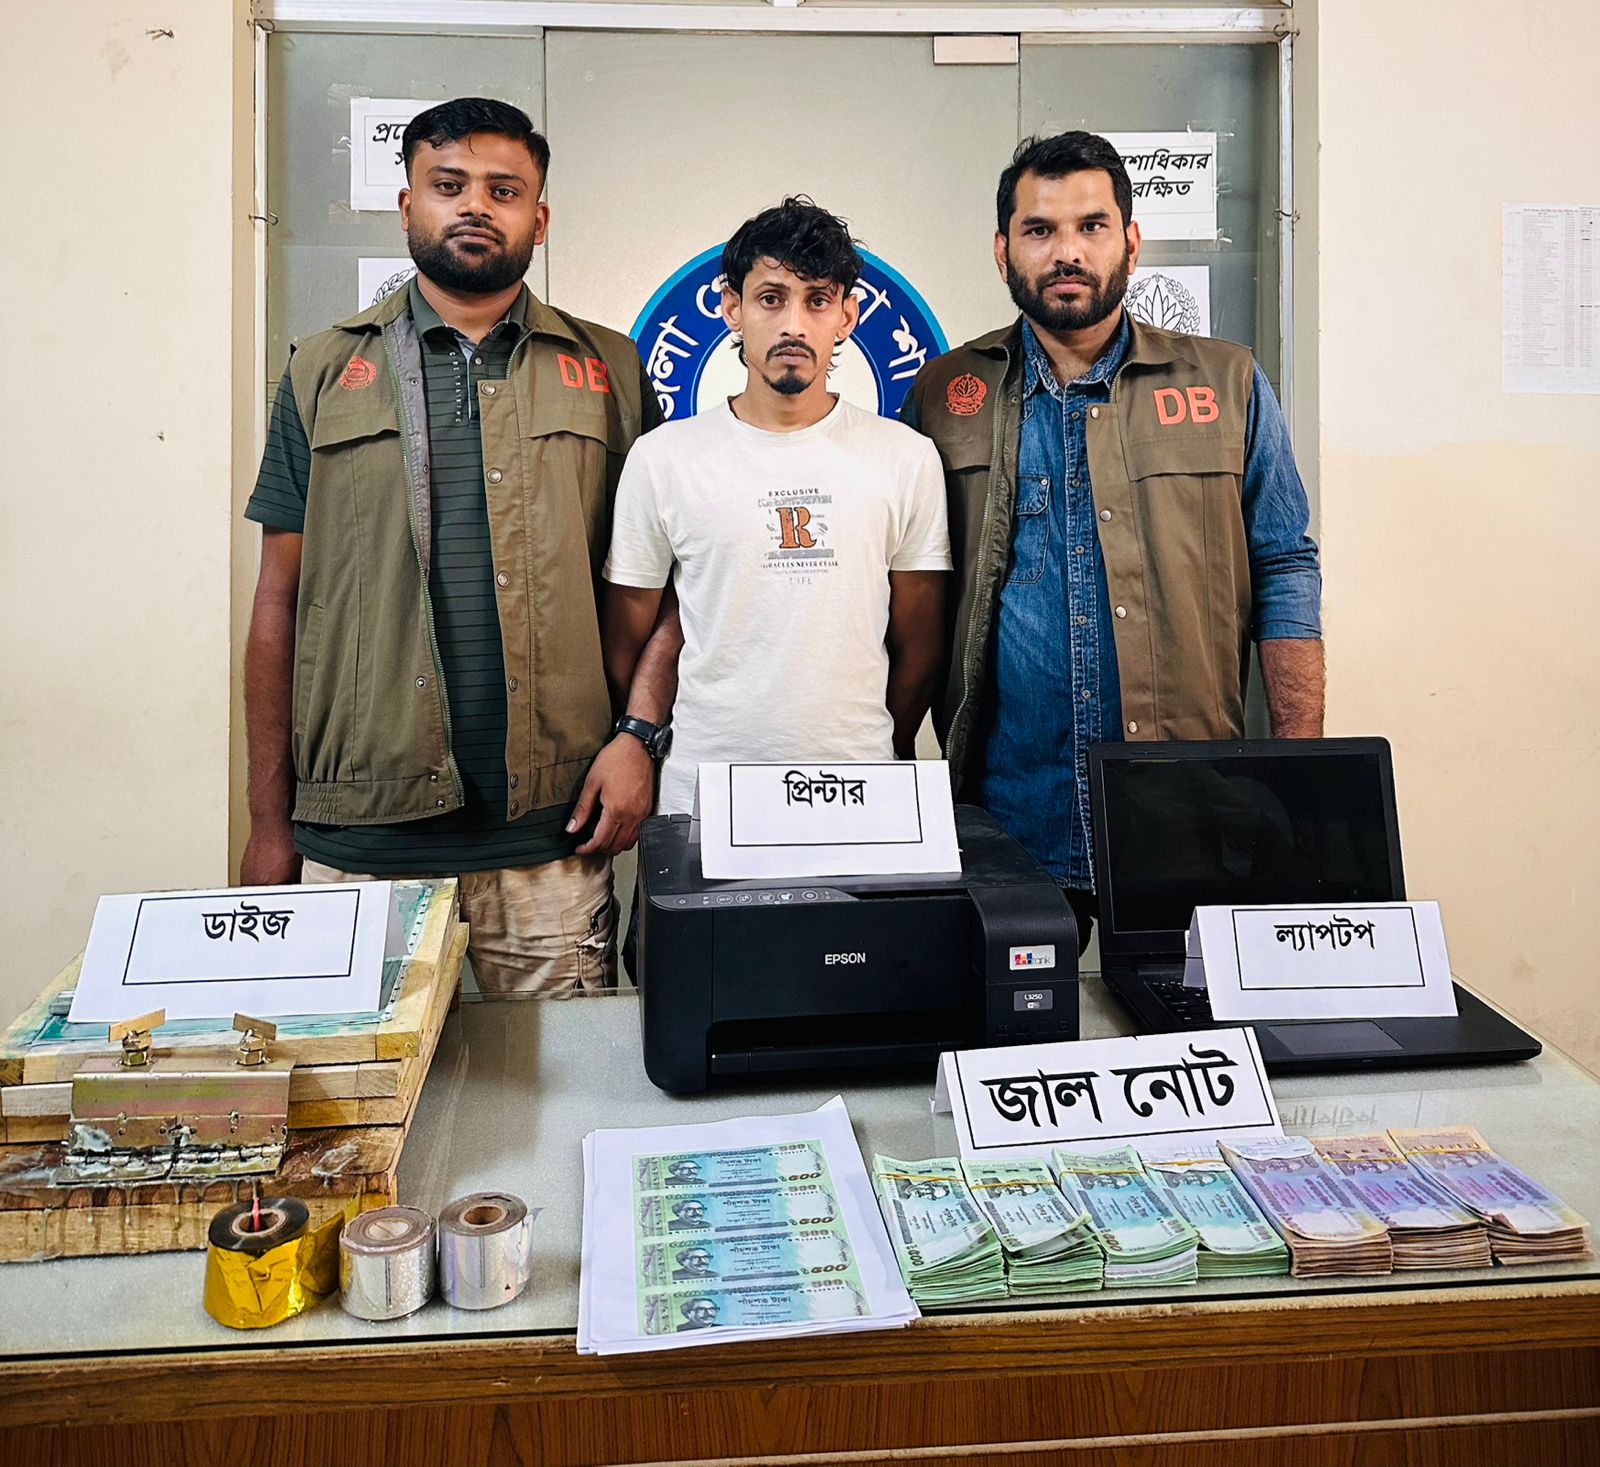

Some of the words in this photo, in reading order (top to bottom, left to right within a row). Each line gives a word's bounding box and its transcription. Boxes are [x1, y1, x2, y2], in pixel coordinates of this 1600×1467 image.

[1132, 175, 1194, 198] রক্ষিত
[557, 353, 610, 393] DB
[1153, 386, 1220, 425] DB
[768, 488, 820, 497] EXCLUSIVE
[776, 506, 818, 549] R
[783, 769, 867, 808] প্রিন্টার
[201, 901, 295, 942] ডাইজ
[1274, 913, 1376, 952] ল্যাপটপ
[824, 953, 866, 965] EPSON
[1024, 993, 1043, 1001] L3250
[980, 1068, 1102, 1128] জাল
[1109, 1043, 1239, 1118] নোট
